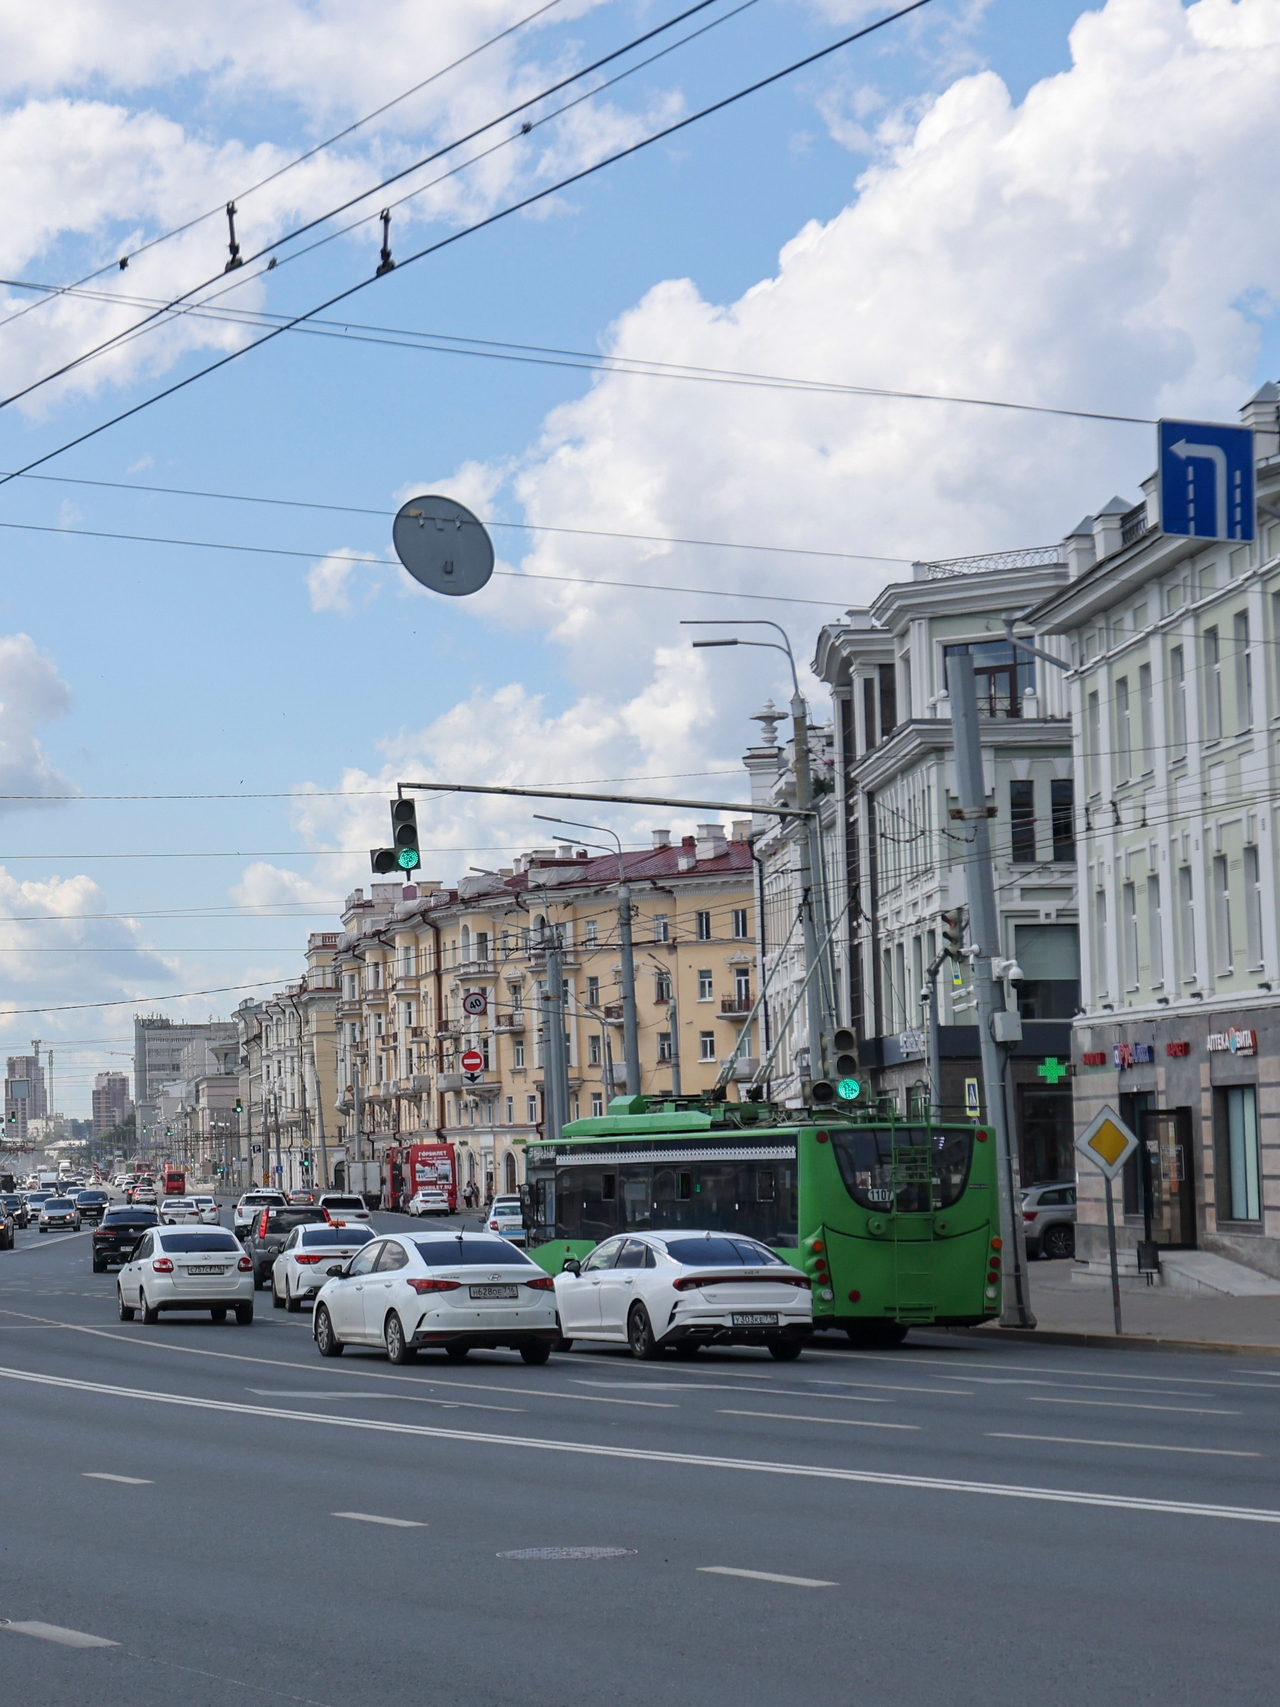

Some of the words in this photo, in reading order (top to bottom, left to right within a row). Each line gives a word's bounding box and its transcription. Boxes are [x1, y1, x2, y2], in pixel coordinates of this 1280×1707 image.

[470, 998, 482, 1009] 40
[1207, 1033, 1230, 1052] АПТЕКА
[1236, 1029, 1253, 1048] ВИТА
[871, 1190, 892, 1200] 1107
